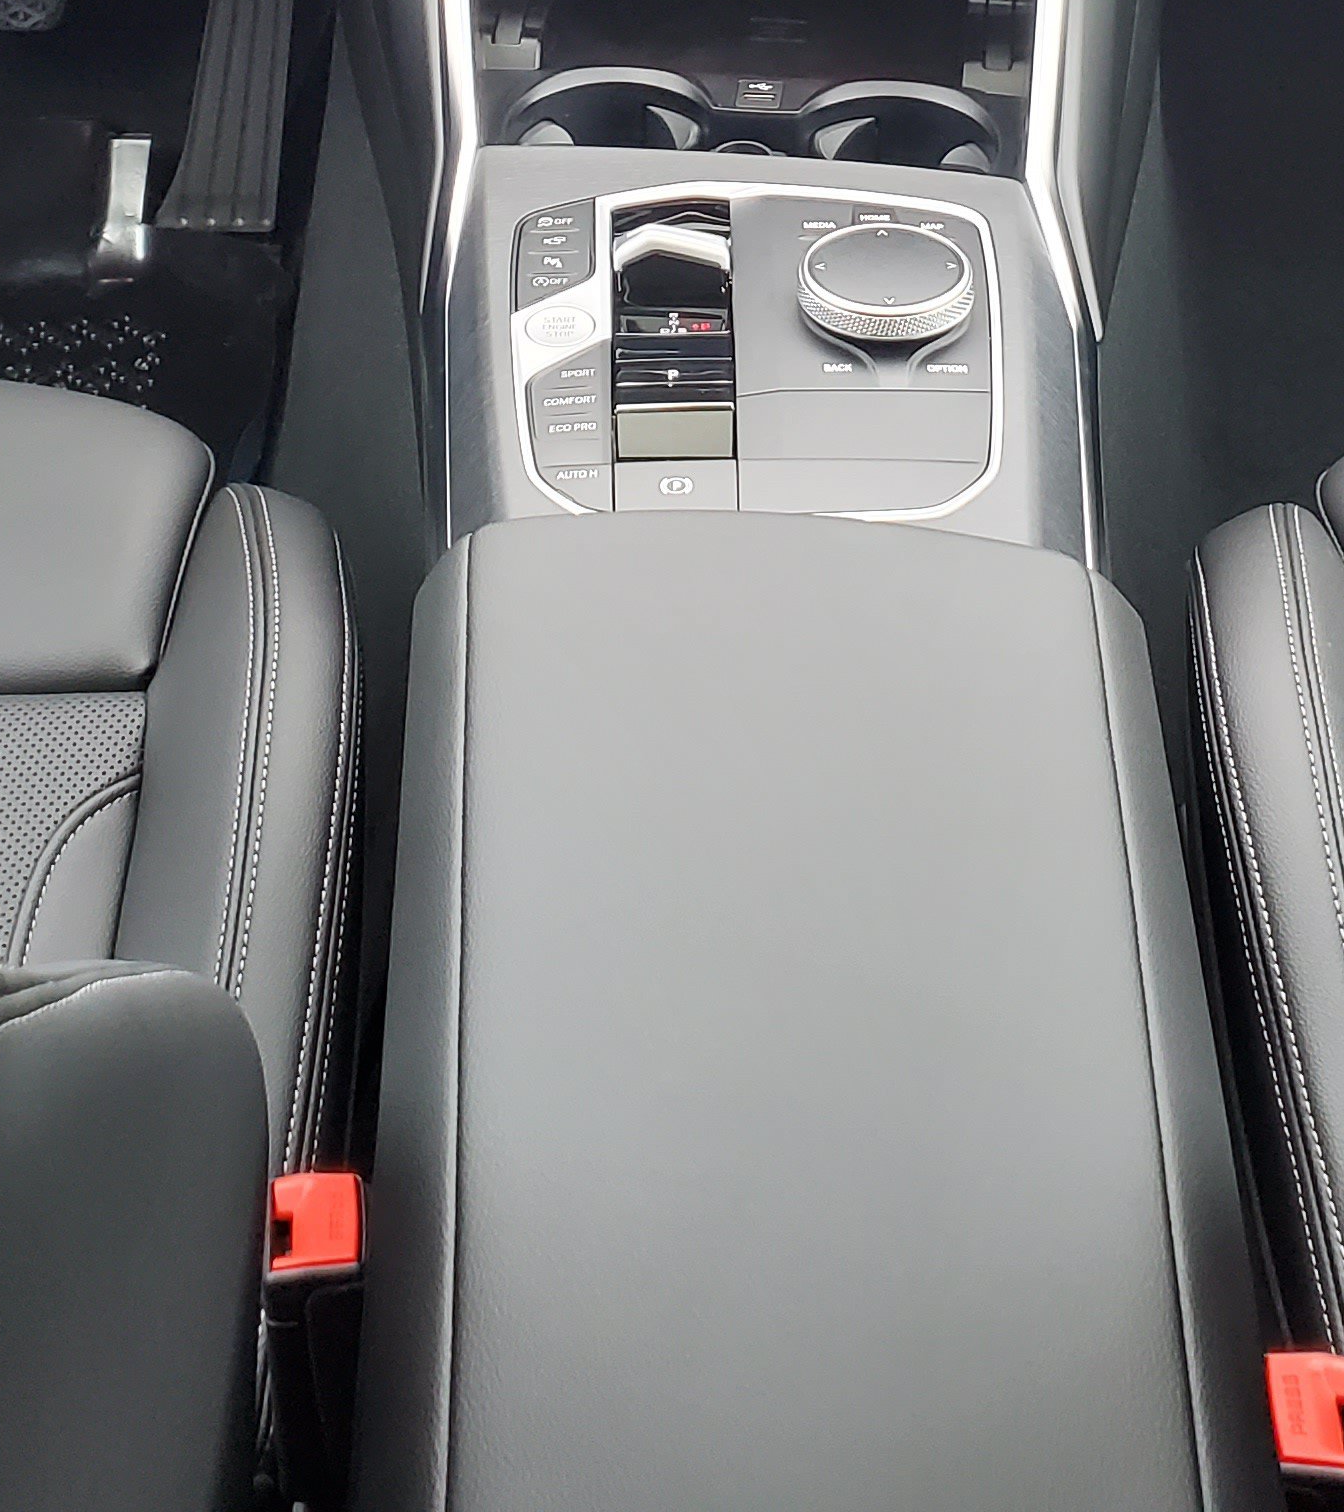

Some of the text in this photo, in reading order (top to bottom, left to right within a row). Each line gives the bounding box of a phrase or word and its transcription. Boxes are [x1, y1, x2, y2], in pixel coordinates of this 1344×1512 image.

[554, 217, 574, 225] OFF
[550, 277, 568, 285] OFF
[560, 367, 596, 378] SPORT
[823, 363, 853, 372] BACK
[927, 364, 969, 374] OPTION
[667, 369, 680, 381] P
[543, 395, 597, 407] COMFORT
[548, 422, 597, 434] ECO PRO
[556, 469, 599, 480] AUTO H
